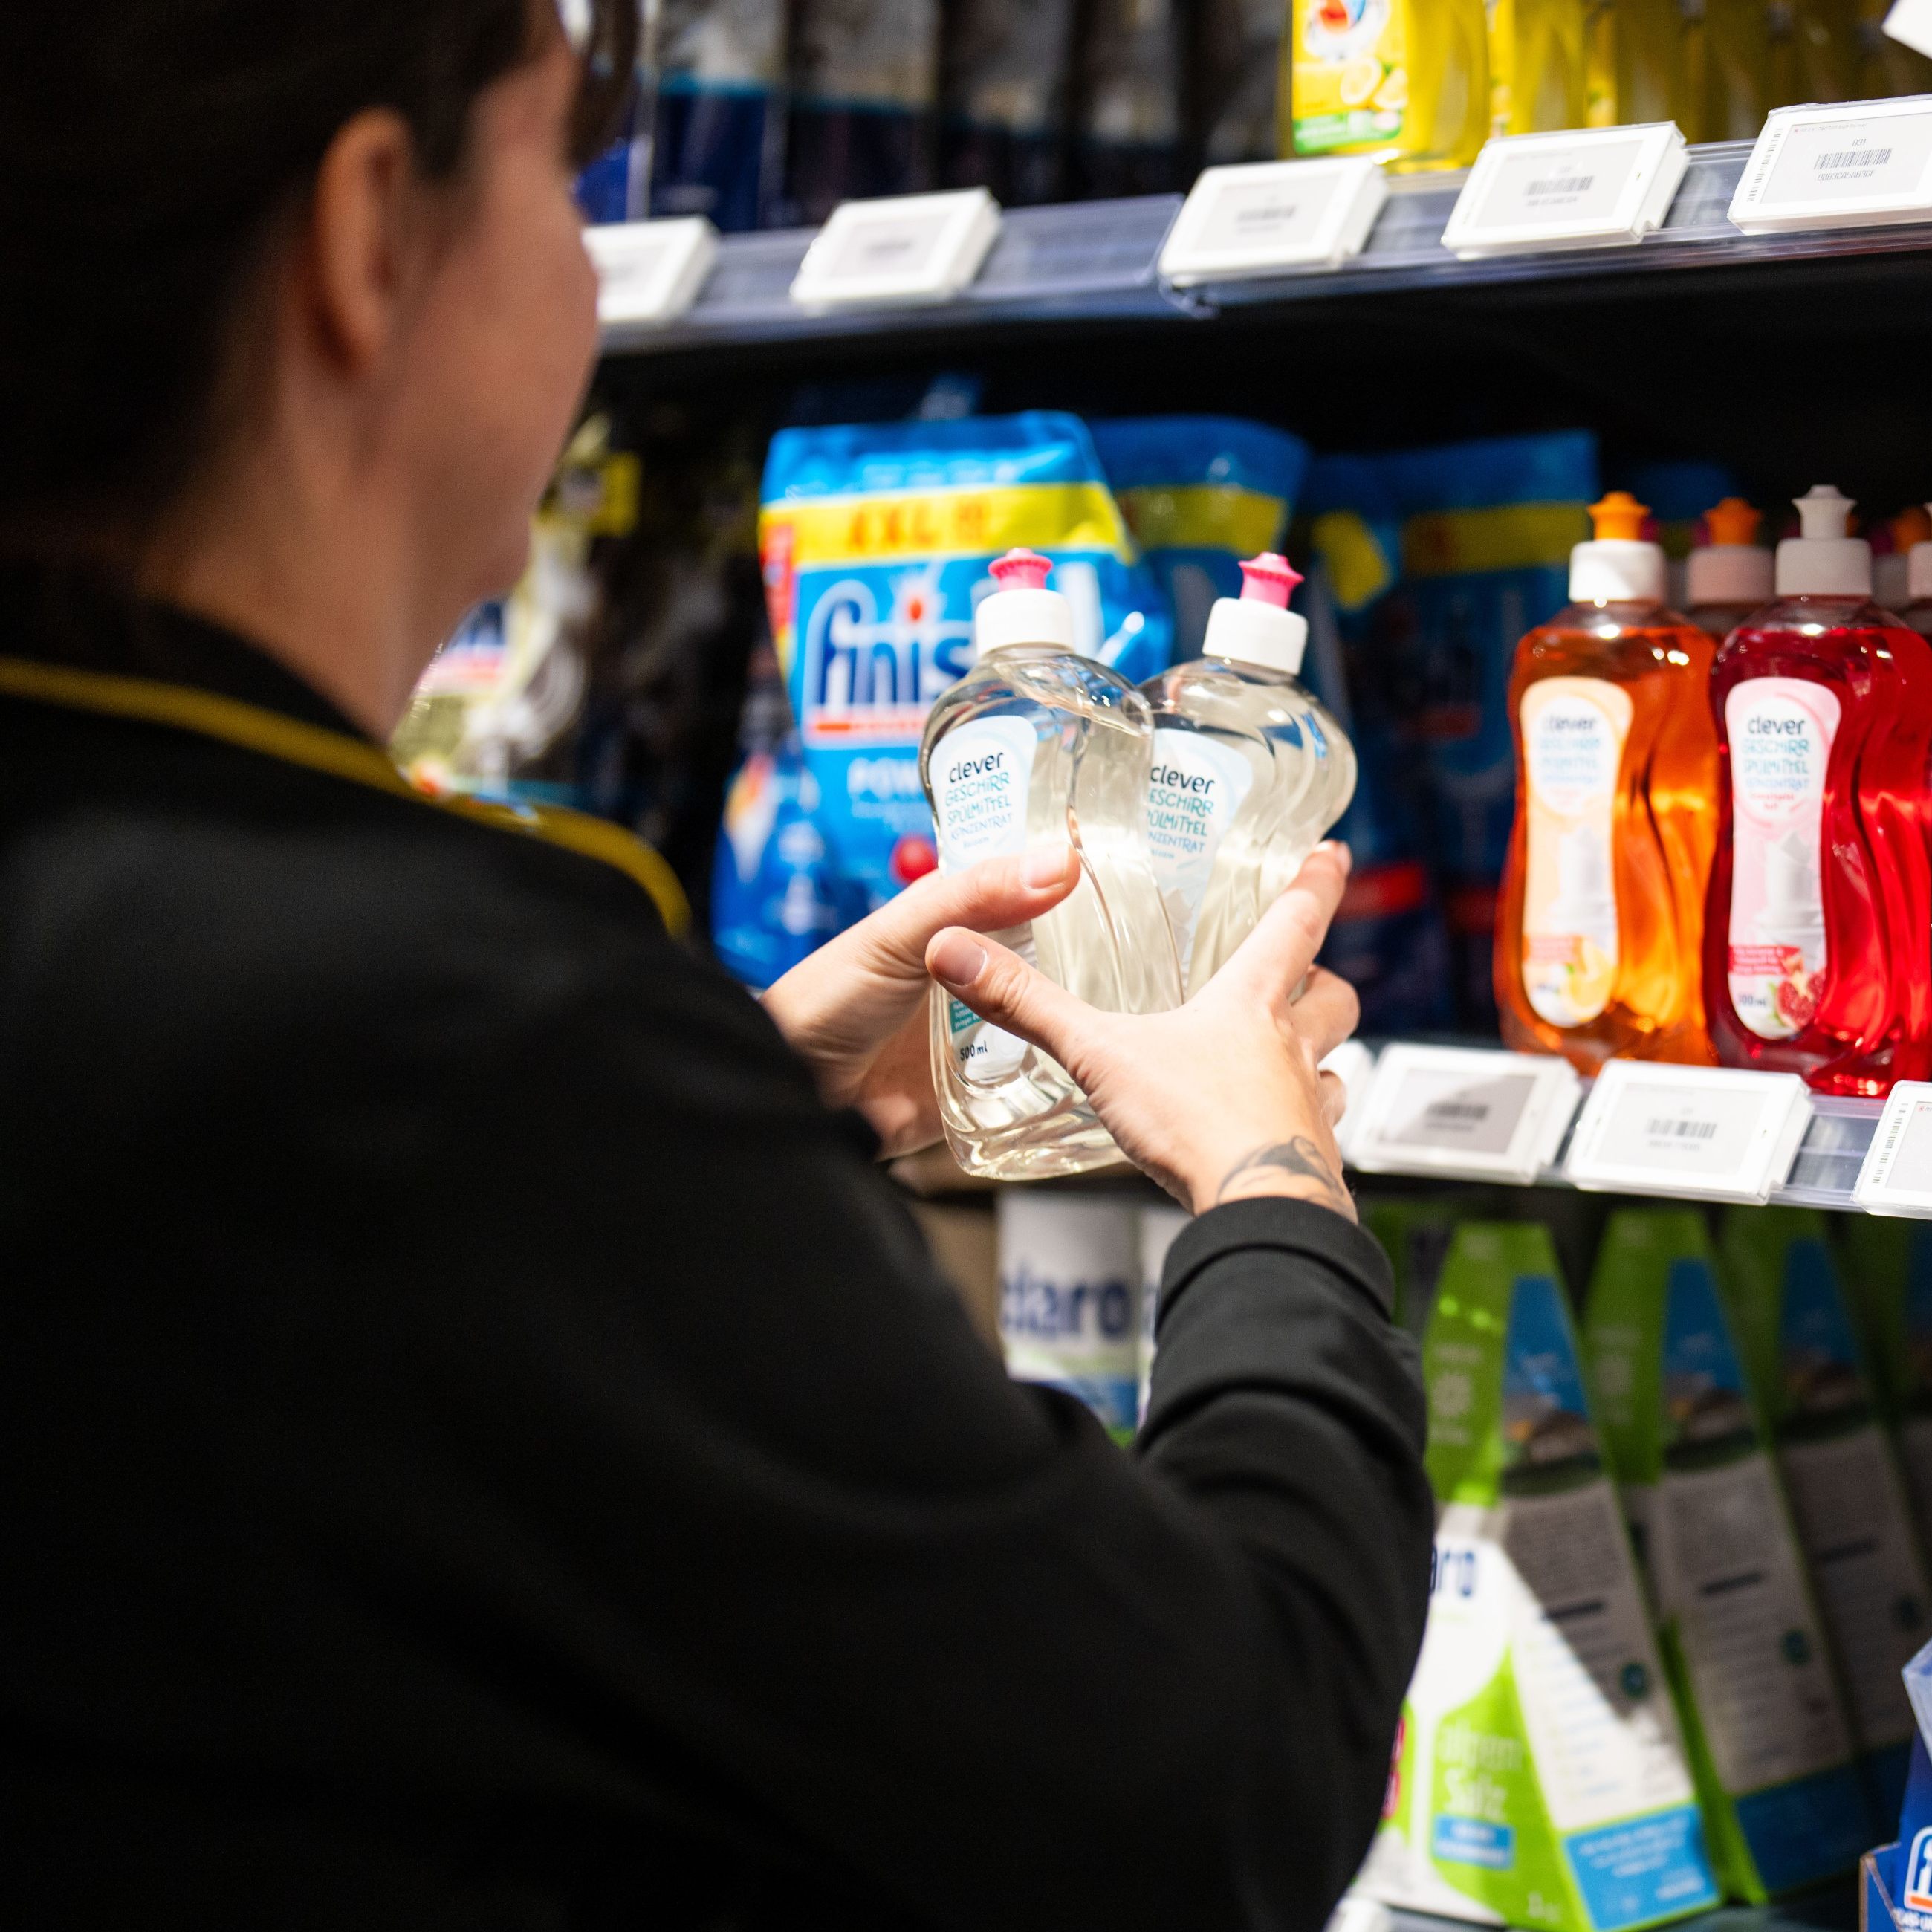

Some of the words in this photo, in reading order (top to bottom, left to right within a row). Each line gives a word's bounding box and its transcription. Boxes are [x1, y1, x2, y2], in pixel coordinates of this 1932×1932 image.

[815, 596, 972, 706] finis
[1747, 716, 1806, 734] clever
[950, 752, 1003, 783] clever
[1150, 765, 1215, 794] clever
[1148, 831, 1205, 853] NZENTRAT
[960, 1043, 976, 1061] 500
[977, 1040, 988, 1054] ml
